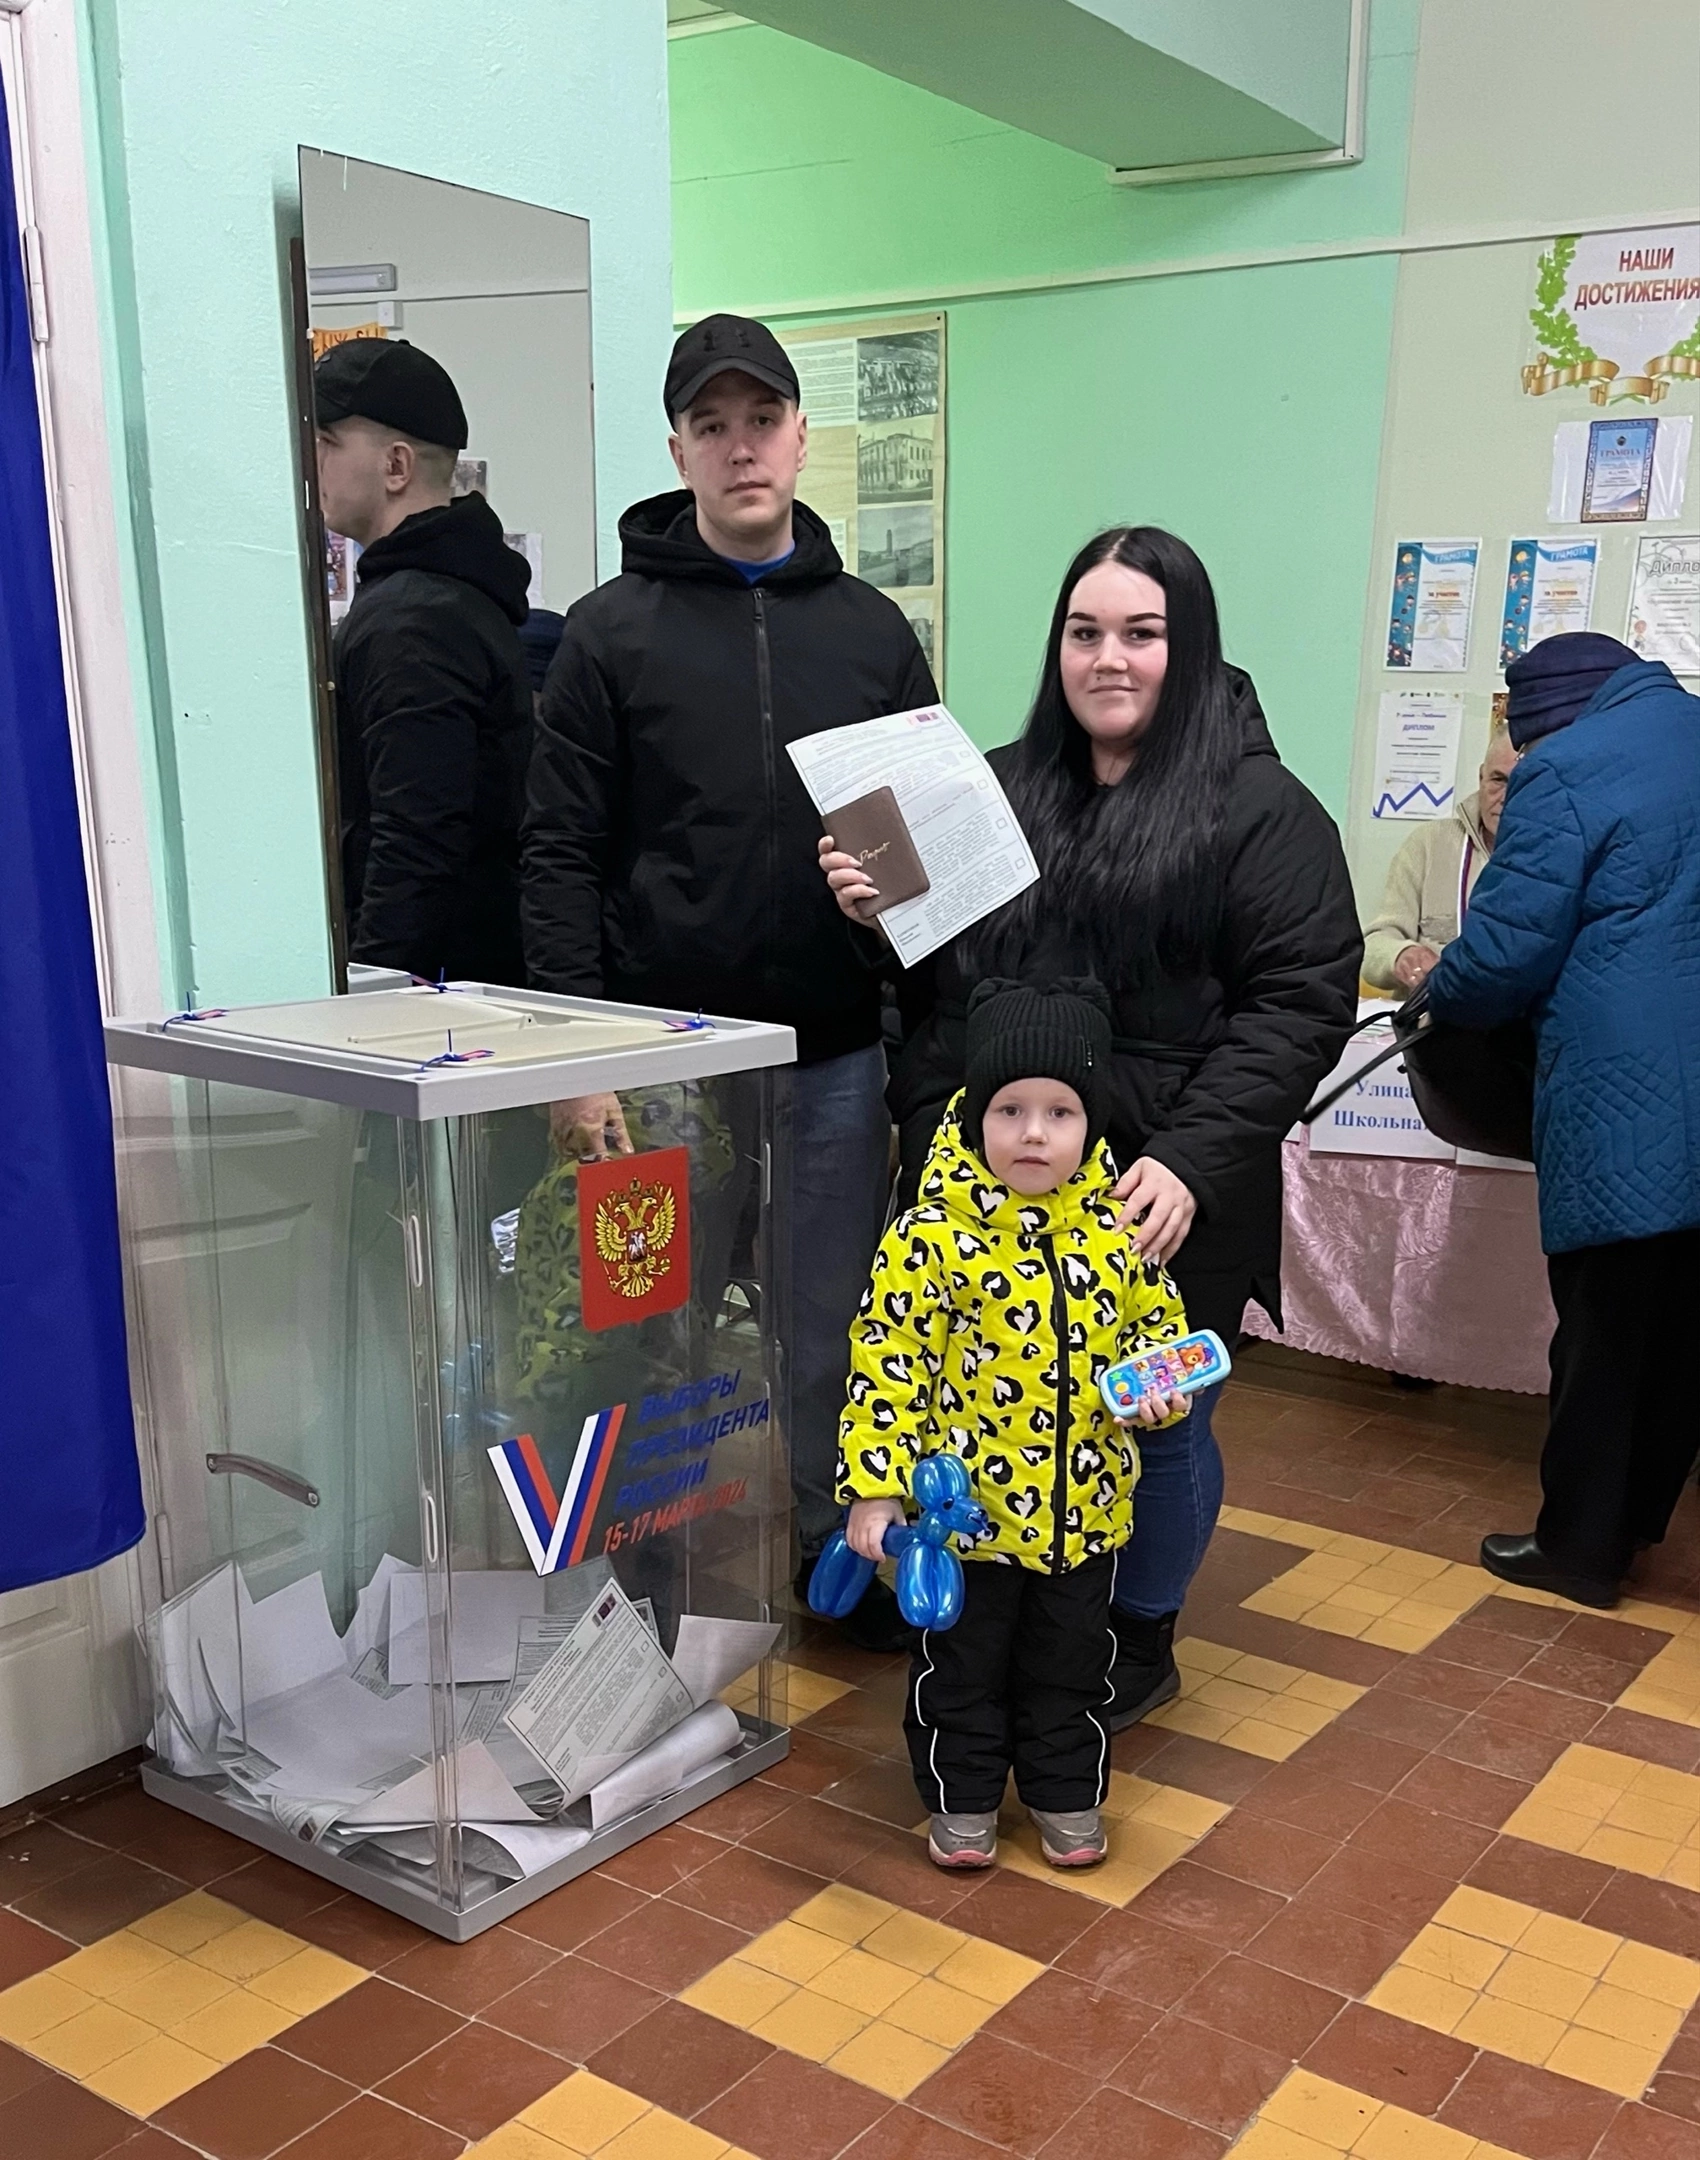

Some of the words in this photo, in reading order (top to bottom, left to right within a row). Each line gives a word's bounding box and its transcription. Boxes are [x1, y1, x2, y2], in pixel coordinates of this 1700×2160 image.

[1619, 247, 1674, 272] НАШИ
[1574, 277, 1700, 311] ДОСТИЖЕНИЯ
[1434, 549, 1470, 562] ГРАМОТА
[1551, 546, 1588, 561] ГРАМОТА
[1334, 1110, 1428, 1131] Школьна
[638, 1369, 742, 1425] ВЫБОРЫ
[624, 1398, 770, 1470] ПРЕЗИДЕНТА
[614, 1458, 708, 1514] РОССИИ
[602, 1511, 652, 1555] 15-17
